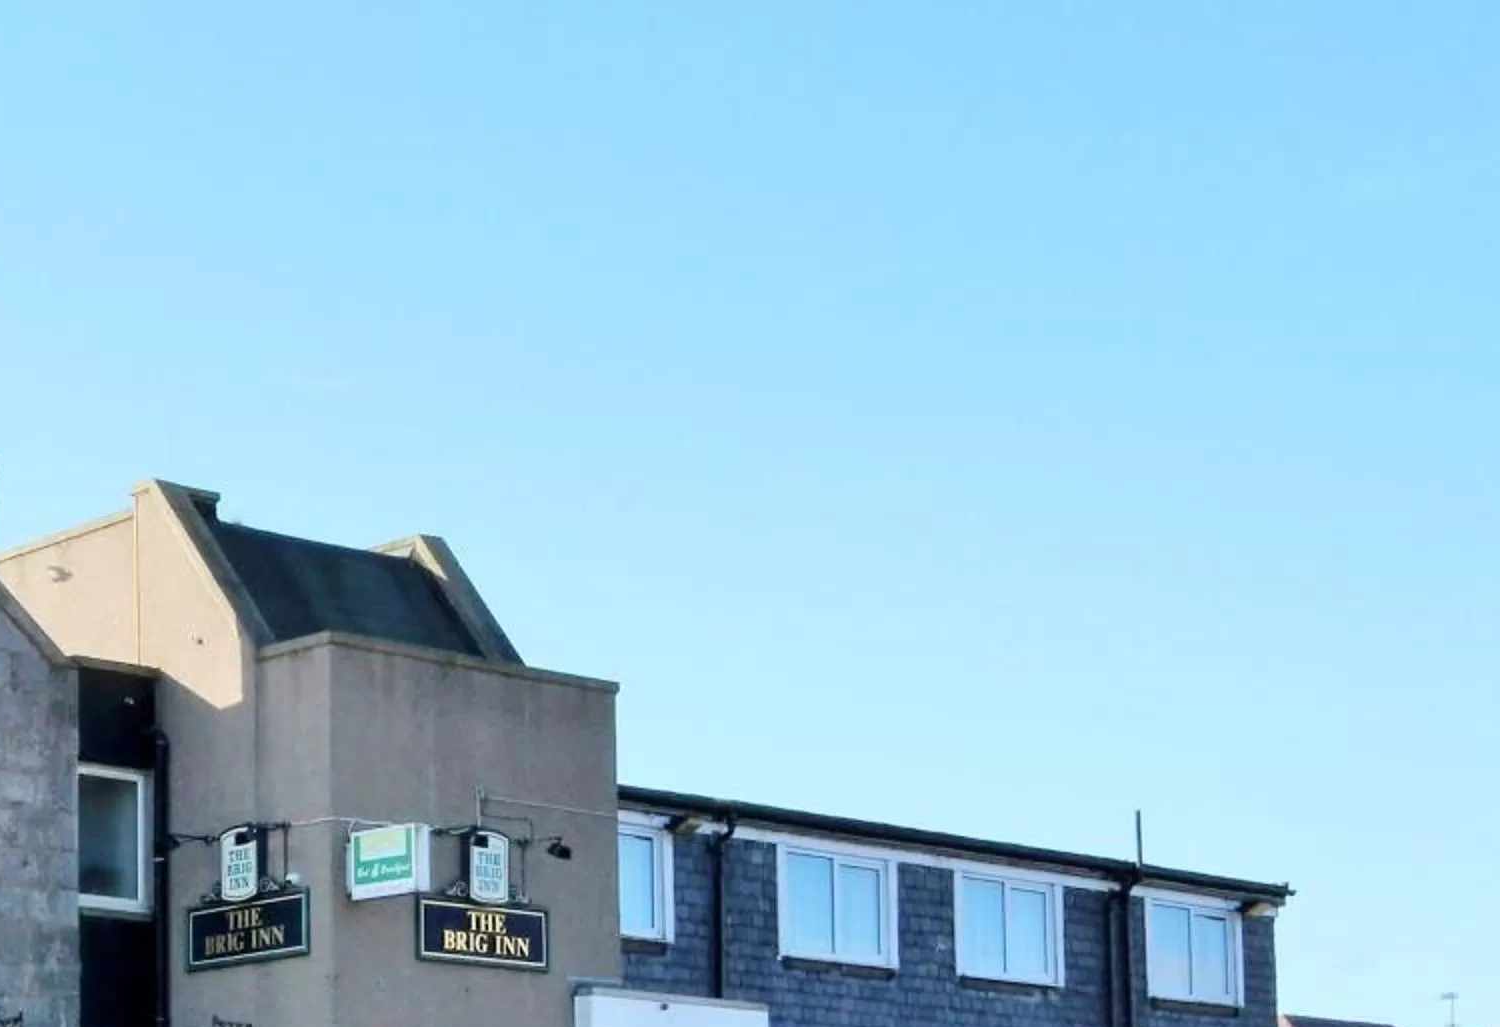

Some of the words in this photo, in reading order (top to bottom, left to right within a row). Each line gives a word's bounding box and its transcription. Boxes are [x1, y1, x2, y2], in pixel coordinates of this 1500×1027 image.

[228, 848, 251, 862] THE
[477, 851, 501, 865] THE
[227, 861, 252, 877] BRIG
[229, 877, 249, 889] INN
[225, 907, 263, 931] THE
[467, 911, 507, 934] THE
[205, 932, 245, 956] BRIG
[251, 924, 285, 949] INN
[443, 929, 489, 953] BRIG
[495, 935, 530, 957] INN
